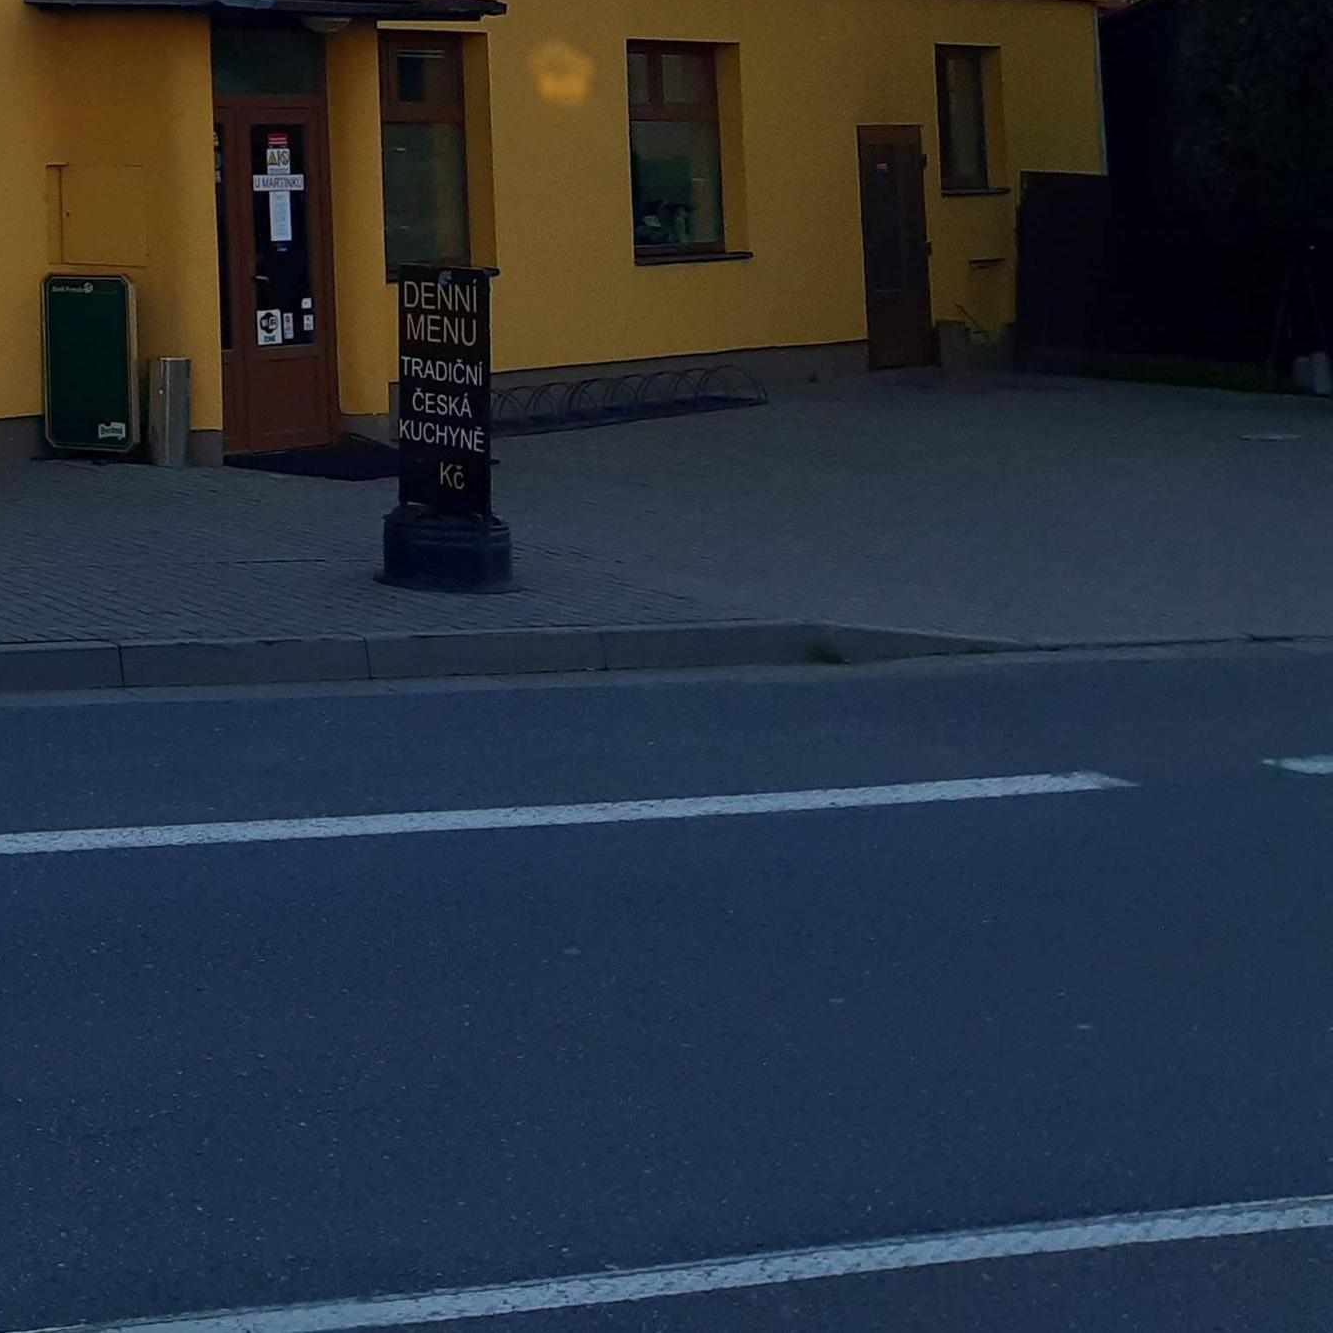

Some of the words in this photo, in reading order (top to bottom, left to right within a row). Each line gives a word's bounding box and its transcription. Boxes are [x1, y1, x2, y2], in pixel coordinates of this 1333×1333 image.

[404, 279, 477, 313] DENNÍ
[407, 314, 477, 346] MENU
[401, 356, 483, 386] TRADIČNÍ
[412, 388, 473, 418] ČESKÁ
[399, 418, 485, 453] KUCHYNĚ
[440, 462, 465, 490] Kč
